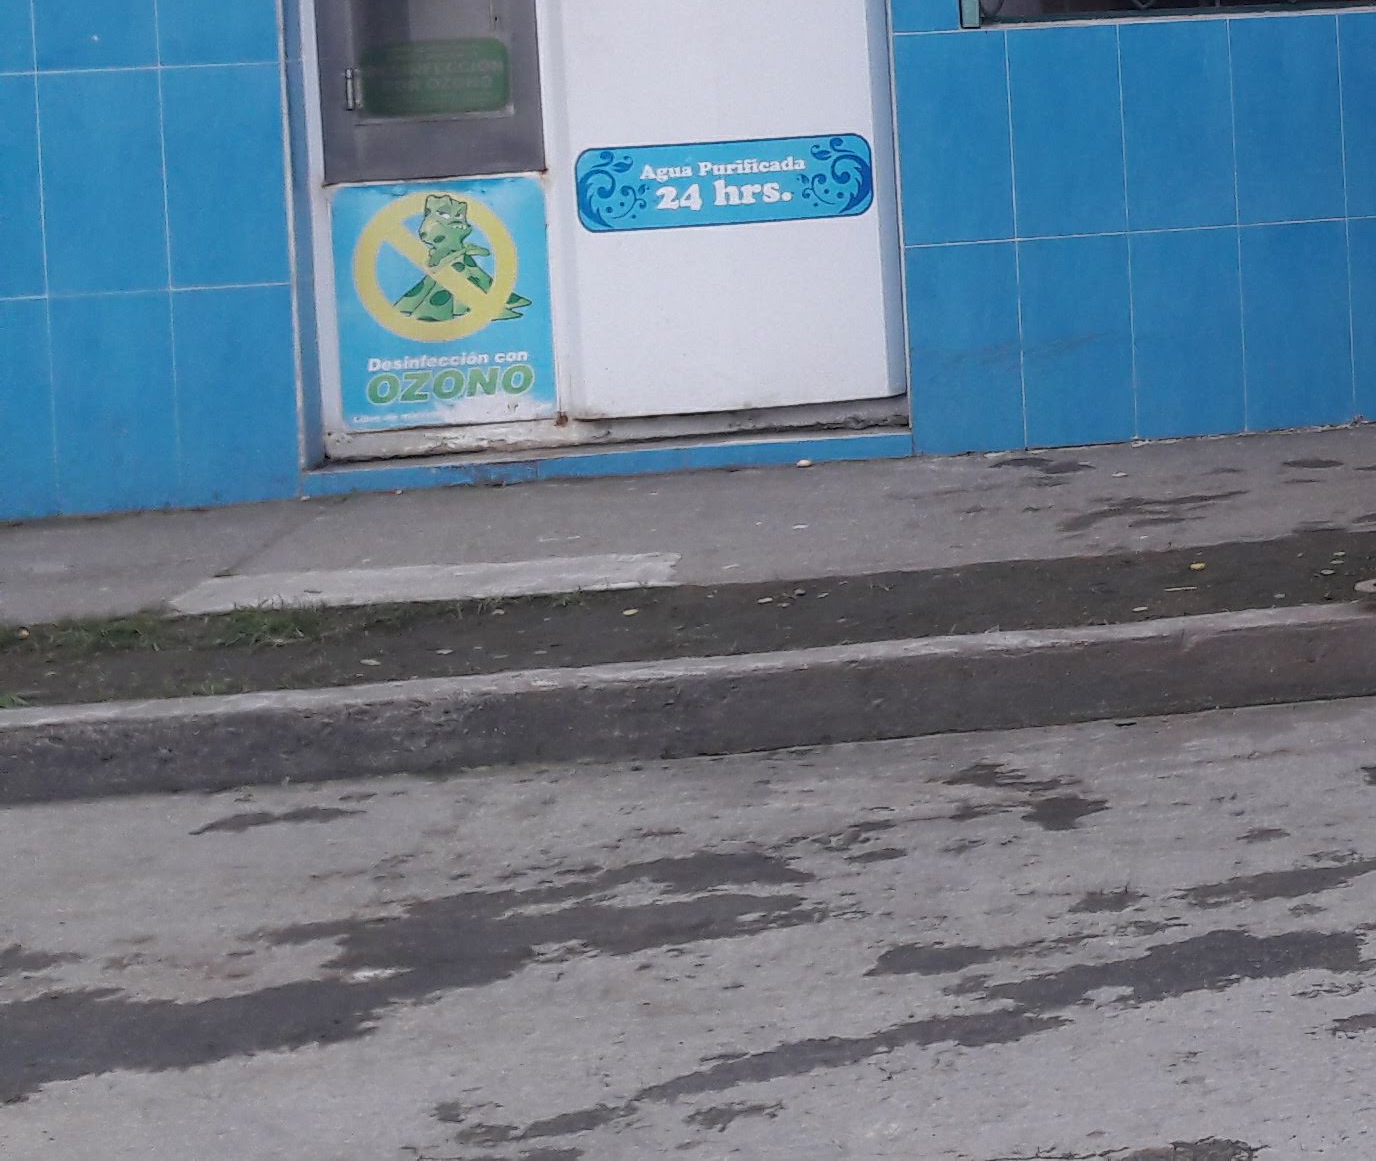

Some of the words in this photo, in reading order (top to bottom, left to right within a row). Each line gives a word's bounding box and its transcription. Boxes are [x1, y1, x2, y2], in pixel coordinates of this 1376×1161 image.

[640, 165, 693, 182] Agua
[697, 155, 805, 177] Purificada
[656, 183, 703, 212] 24
[713, 179, 793, 207] hrs.
[367, 352, 488, 372] Desinfección
[494, 350, 528, 363] con
[367, 364, 536, 405] OZONO
